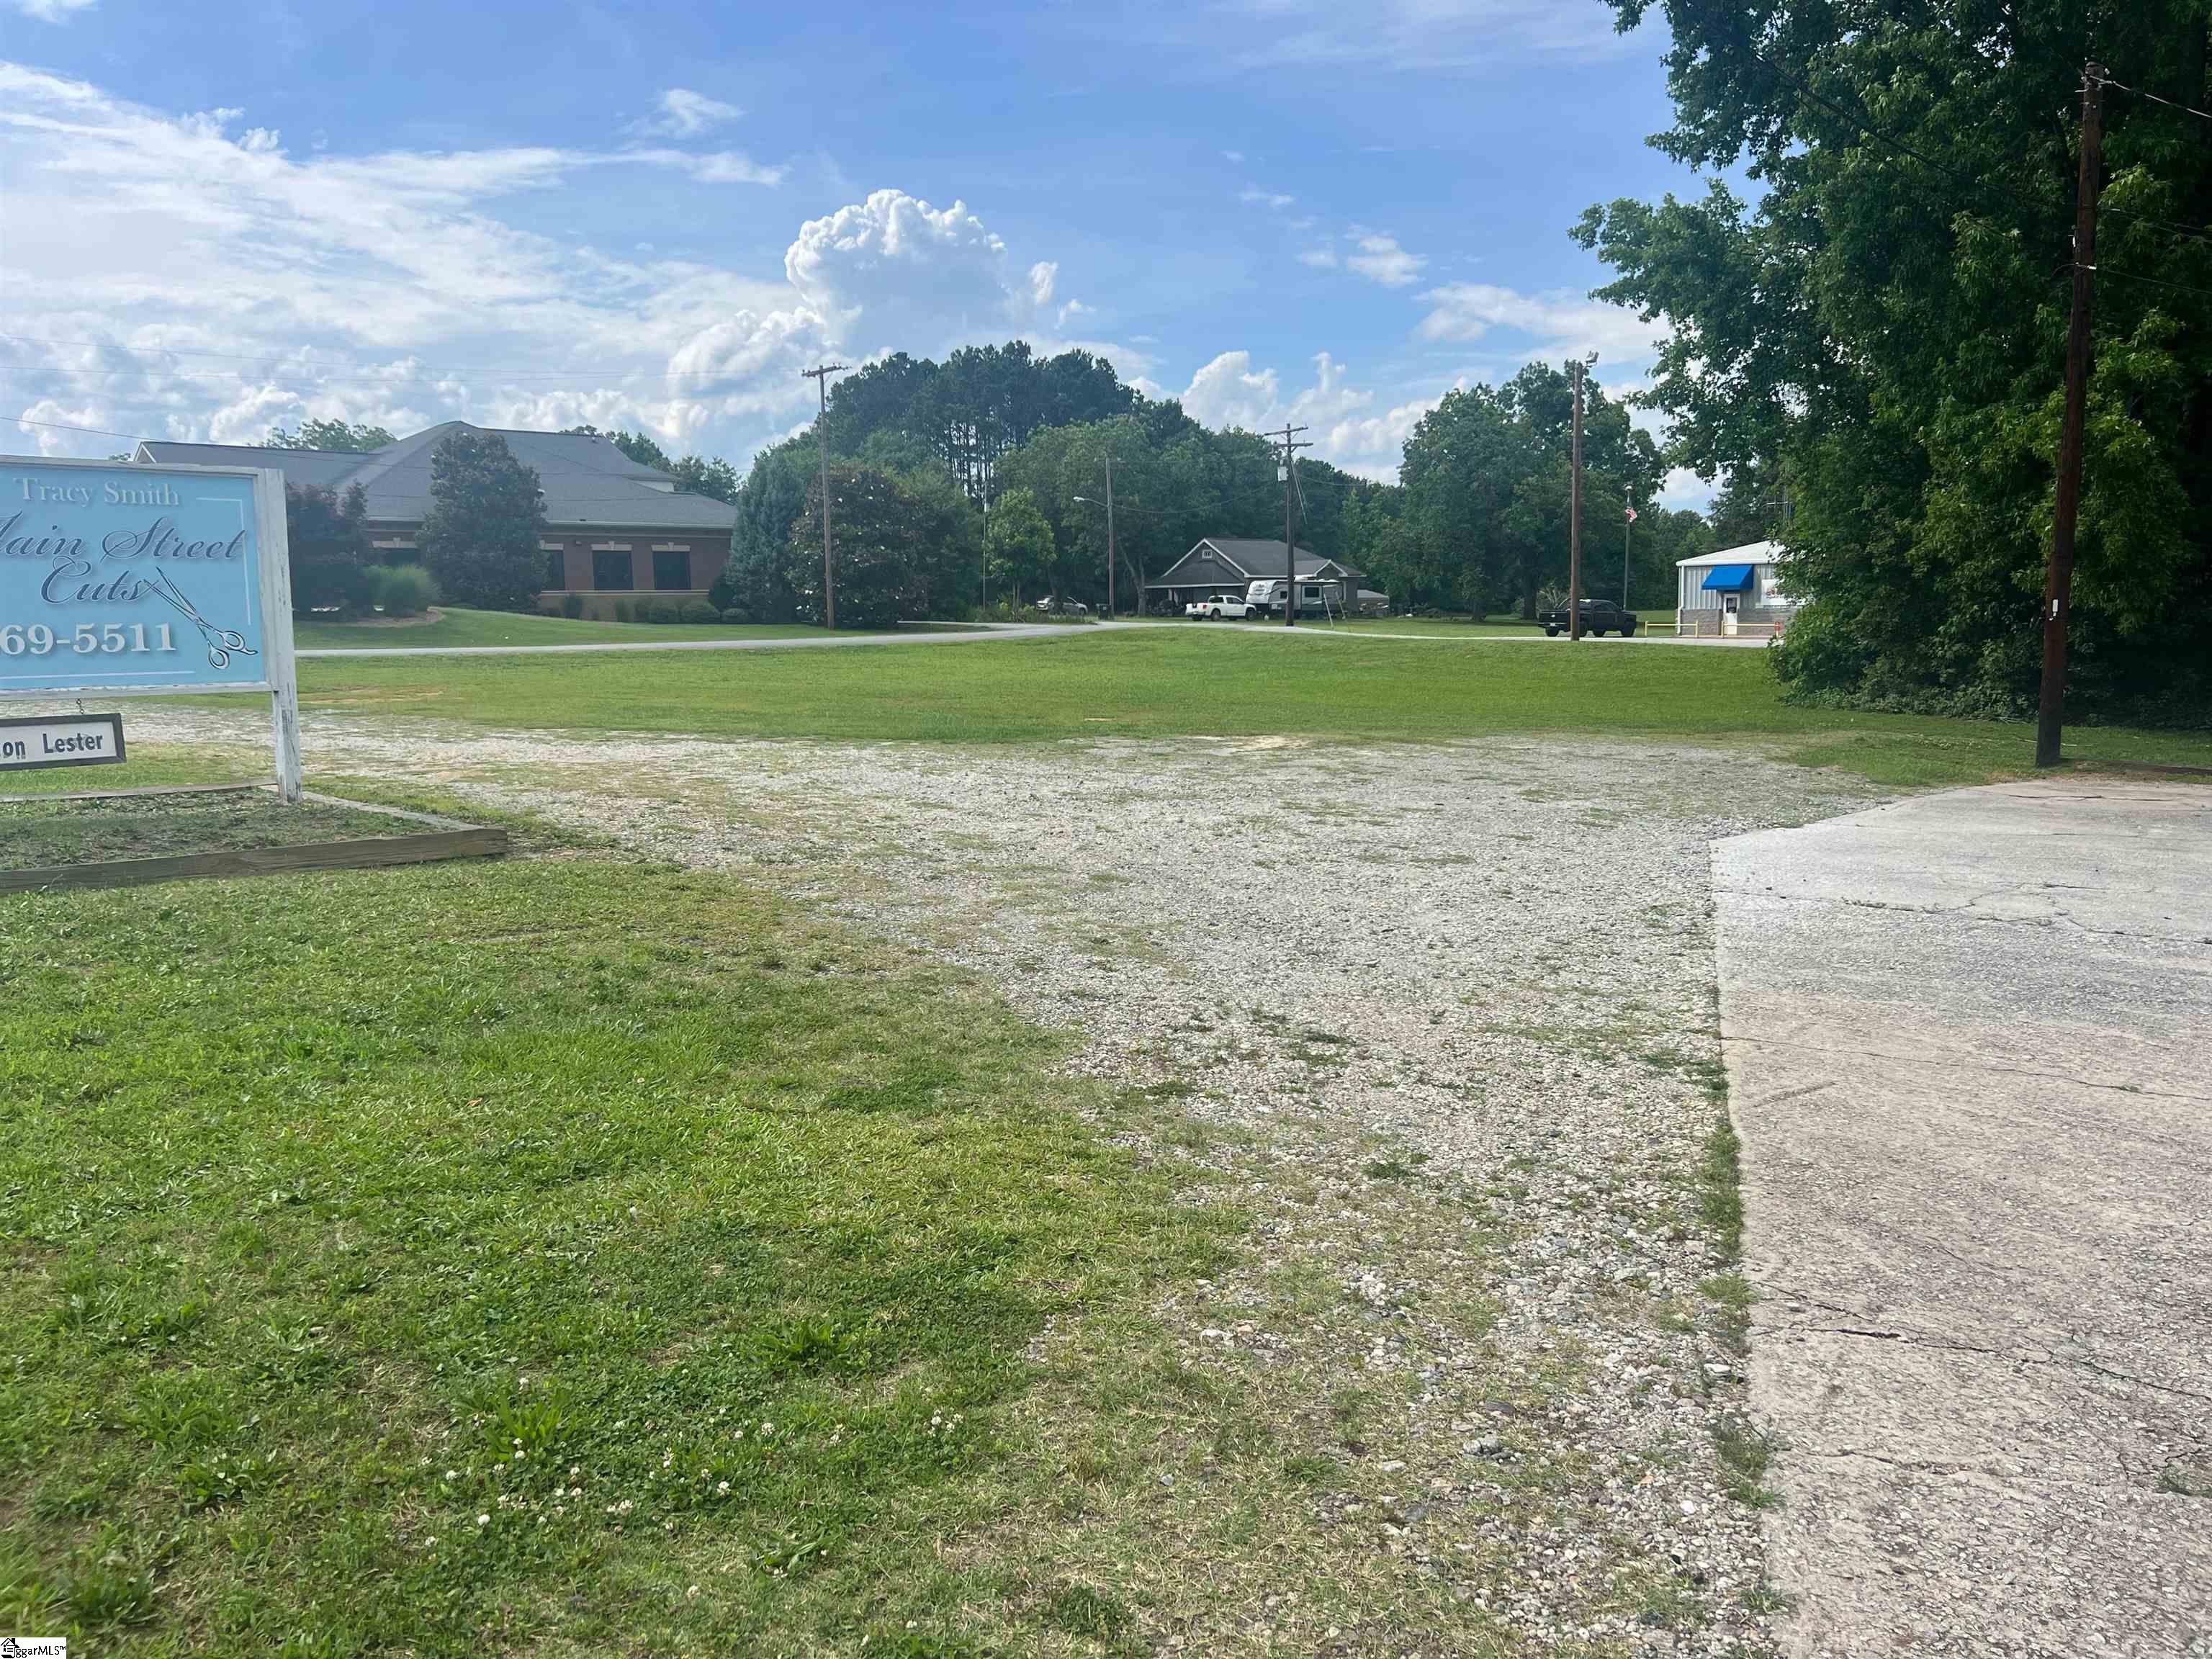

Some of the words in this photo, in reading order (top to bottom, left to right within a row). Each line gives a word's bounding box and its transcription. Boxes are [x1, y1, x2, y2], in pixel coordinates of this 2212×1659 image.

[13, 477, 94, 506] Tracy
[104, 481, 179, 505] Smith
[99, 516, 246, 564] Street
[40, 555, 160, 603] Cuts
[0, 622, 176, 655] 69-5511
[42, 733, 103, 754] Lester
